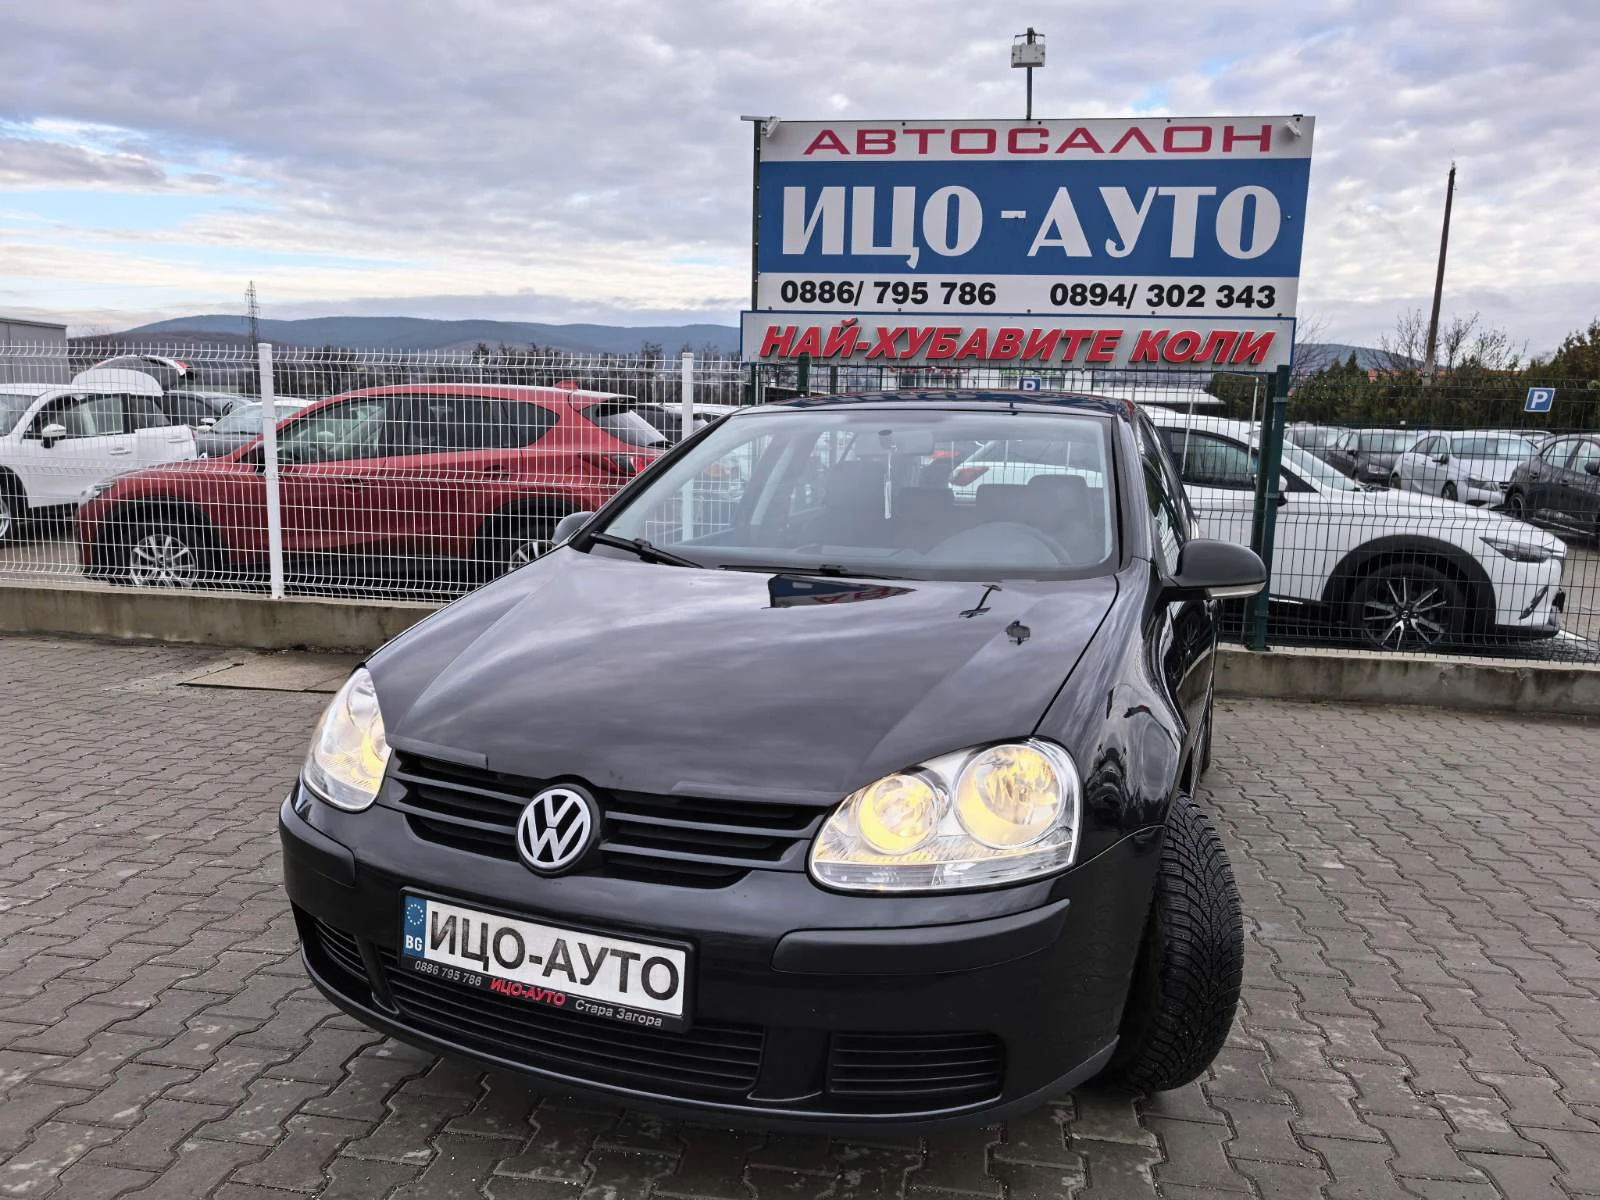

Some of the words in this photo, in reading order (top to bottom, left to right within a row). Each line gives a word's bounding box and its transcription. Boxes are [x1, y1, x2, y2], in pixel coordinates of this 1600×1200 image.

[804, 124, 1272, 156] АВТОСАЛОН
[780, 280, 864, 306] 0886/
[874, 281, 929, 305] 795
[940, 282, 997, 306] 786
[1049, 283, 1137, 308] 0894/
[1146, 284, 1205, 308] 302
[1216, 285, 1276, 309] 343
[758, 318, 1123, 363] НАЙ-ХУБАВИТЕ
[1129, 328, 1276, 365] КОЛИ
[1531, 391, 1548, 408] P
[405, 934, 423, 952] BG
[429, 910, 680, 1001] ИЦО-АУТО
[414, 960, 440, 975] 0886
[441, 967, 461, 981] 795
[463, 973, 483, 987] 786
[489, 978, 566, 1007] ИЦО-АУТО
[575, 999, 614, 1018] Стара
[616, 1008, 664, 1027] Загора
